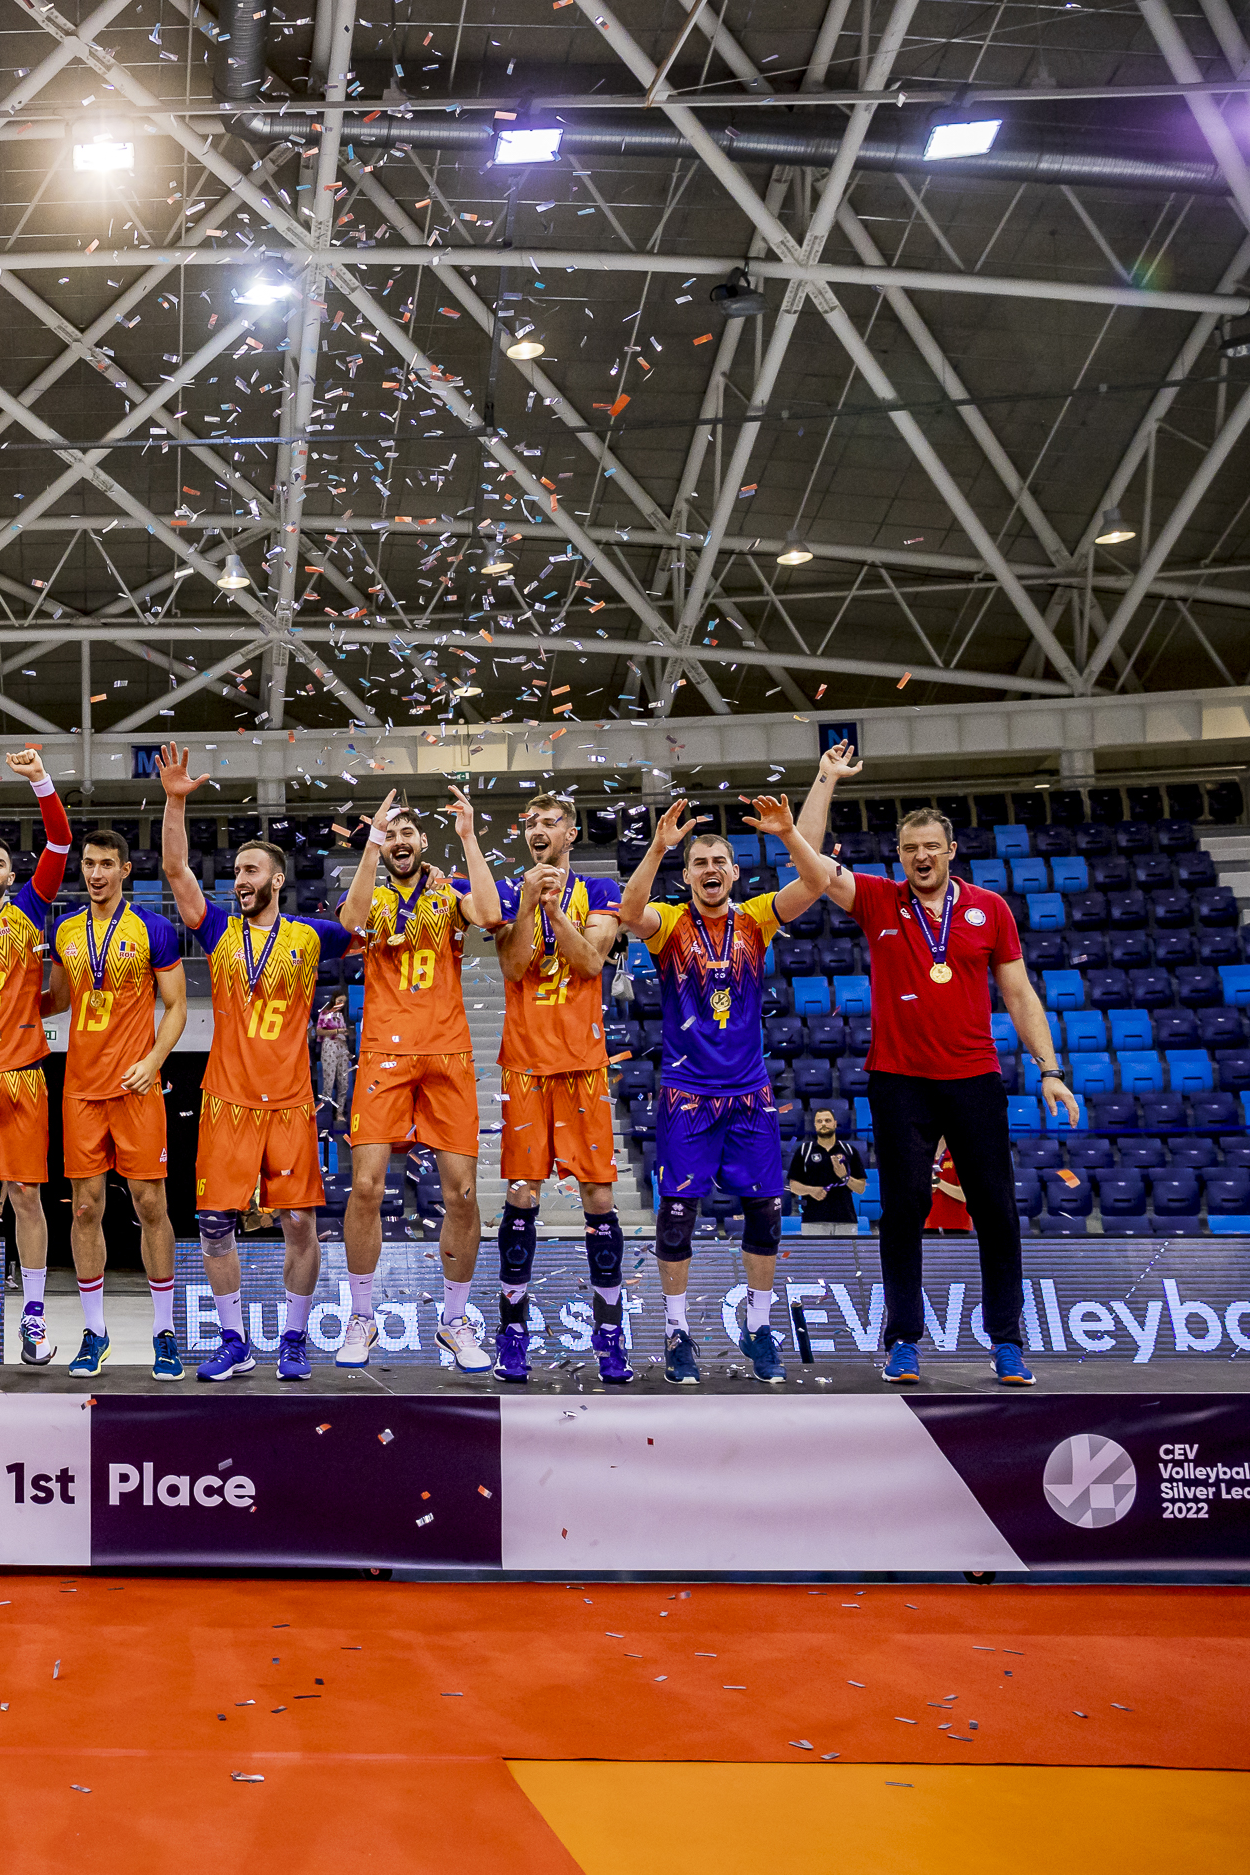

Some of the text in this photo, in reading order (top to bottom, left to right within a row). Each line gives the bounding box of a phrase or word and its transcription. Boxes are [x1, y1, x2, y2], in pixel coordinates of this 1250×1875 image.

[137, 751, 161, 774] M
[398, 949, 436, 990] 18
[77, 990, 114, 1032] 13
[247, 998, 287, 1040] 16
[721, 1282, 887, 1352] CEV
[1158, 1443, 1199, 1460] CEV
[5, 1461, 256, 1508] 1st Place
[1158, 1462, 1250, 1483] Volleybal
[1160, 1481, 1216, 1499] Silver
[1161, 1501, 1209, 1518] 2022
